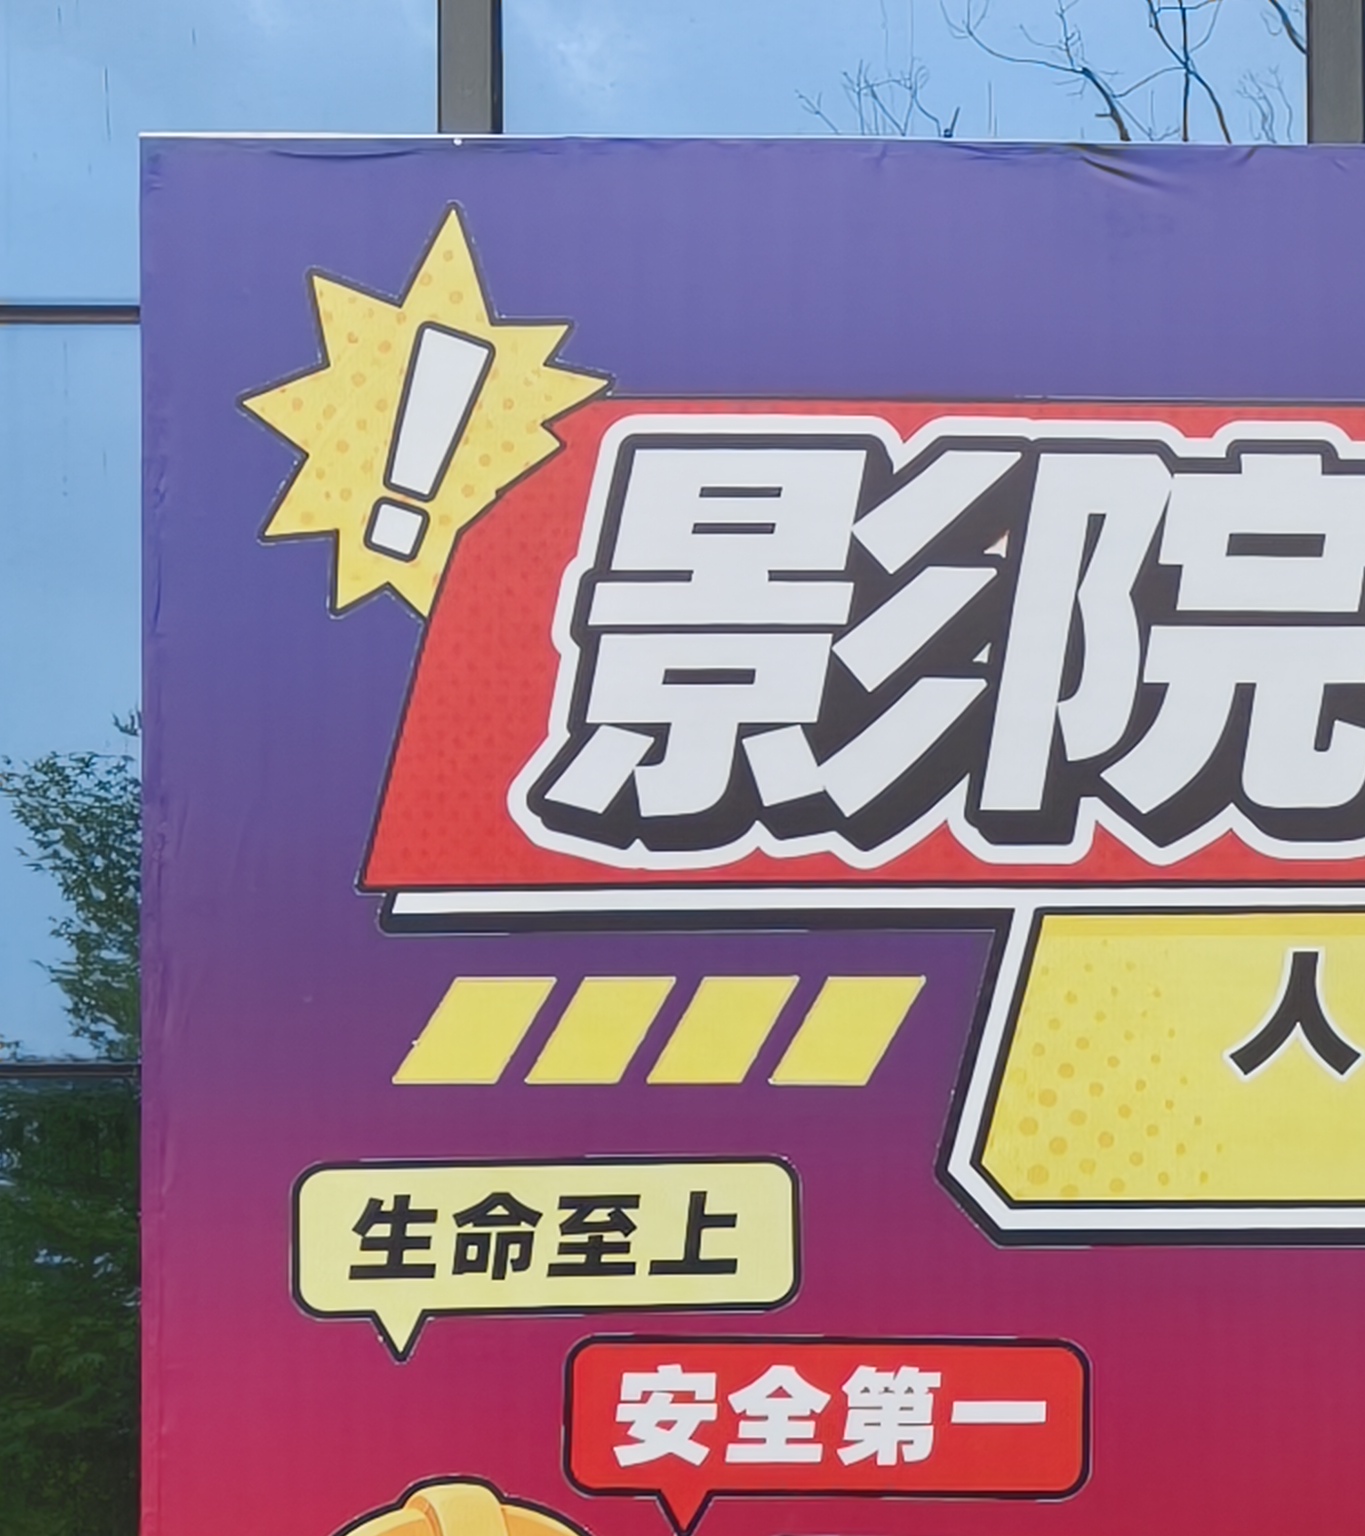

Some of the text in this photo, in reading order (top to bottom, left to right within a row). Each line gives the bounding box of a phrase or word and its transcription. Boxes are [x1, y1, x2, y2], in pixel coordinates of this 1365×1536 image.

[349, 1190, 738, 1281] 生命至上
[613, 1364, 1046, 1467] 安全第一
